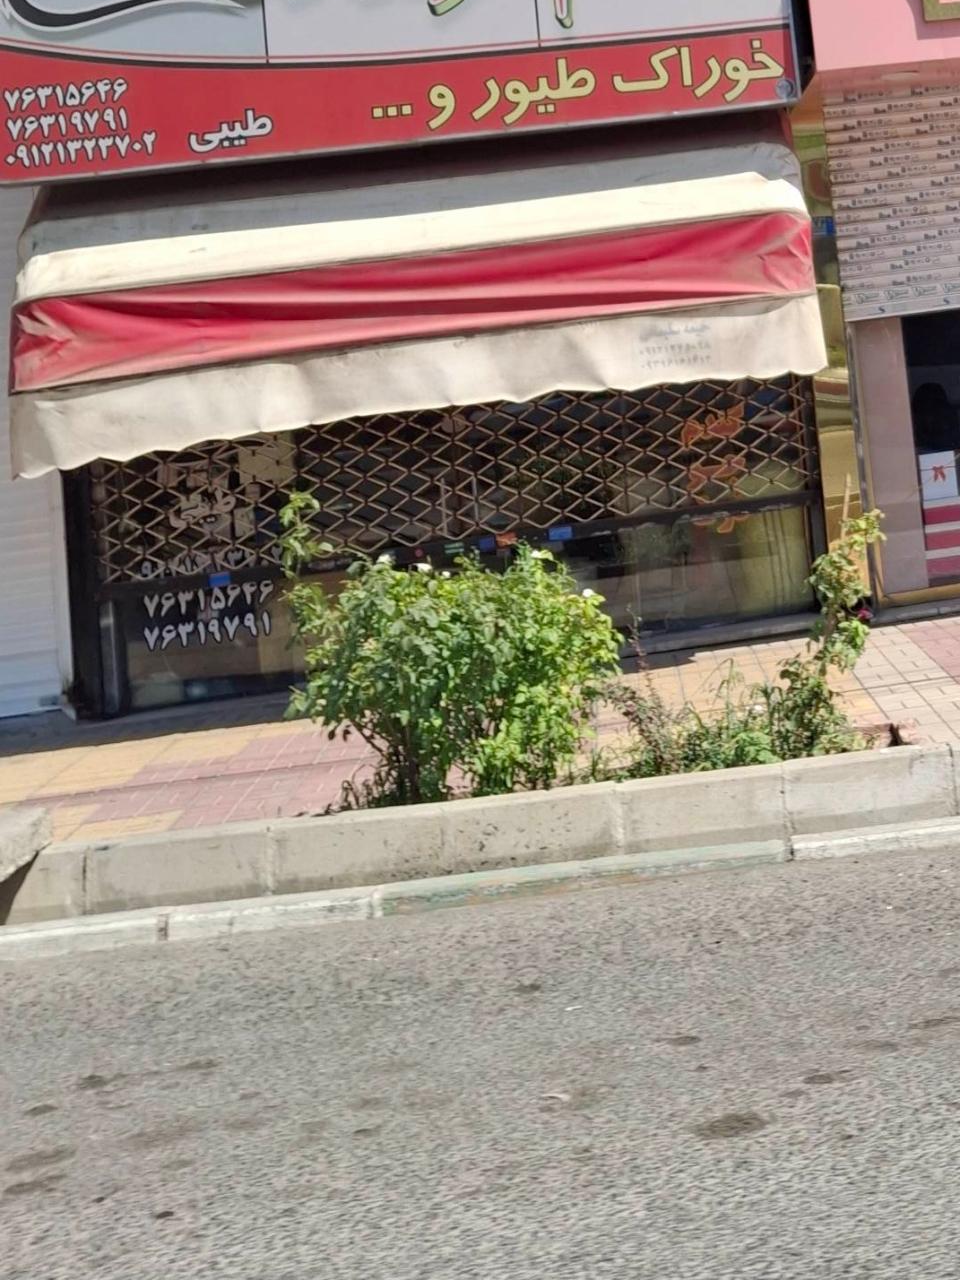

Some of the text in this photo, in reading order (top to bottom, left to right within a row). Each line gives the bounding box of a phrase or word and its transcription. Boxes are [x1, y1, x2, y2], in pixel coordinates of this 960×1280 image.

[470, 57, 597, 126] طیور
[612, 38, 785, 103] خوراک
[4, 77, 128, 112] ۷۶۳۱۵۶۴۶
[426, 82, 457, 130] و
[6, 106, 128, 141] ۷۶۳۱۹۷۹۱
[189, 108, 274, 153] طیبی
[5, 130, 156, 167] ۰۹۱۲۱۳۲۳۷۰۲
[143, 610, 272, 651] ۷۶۳۱۹۷۹۱
